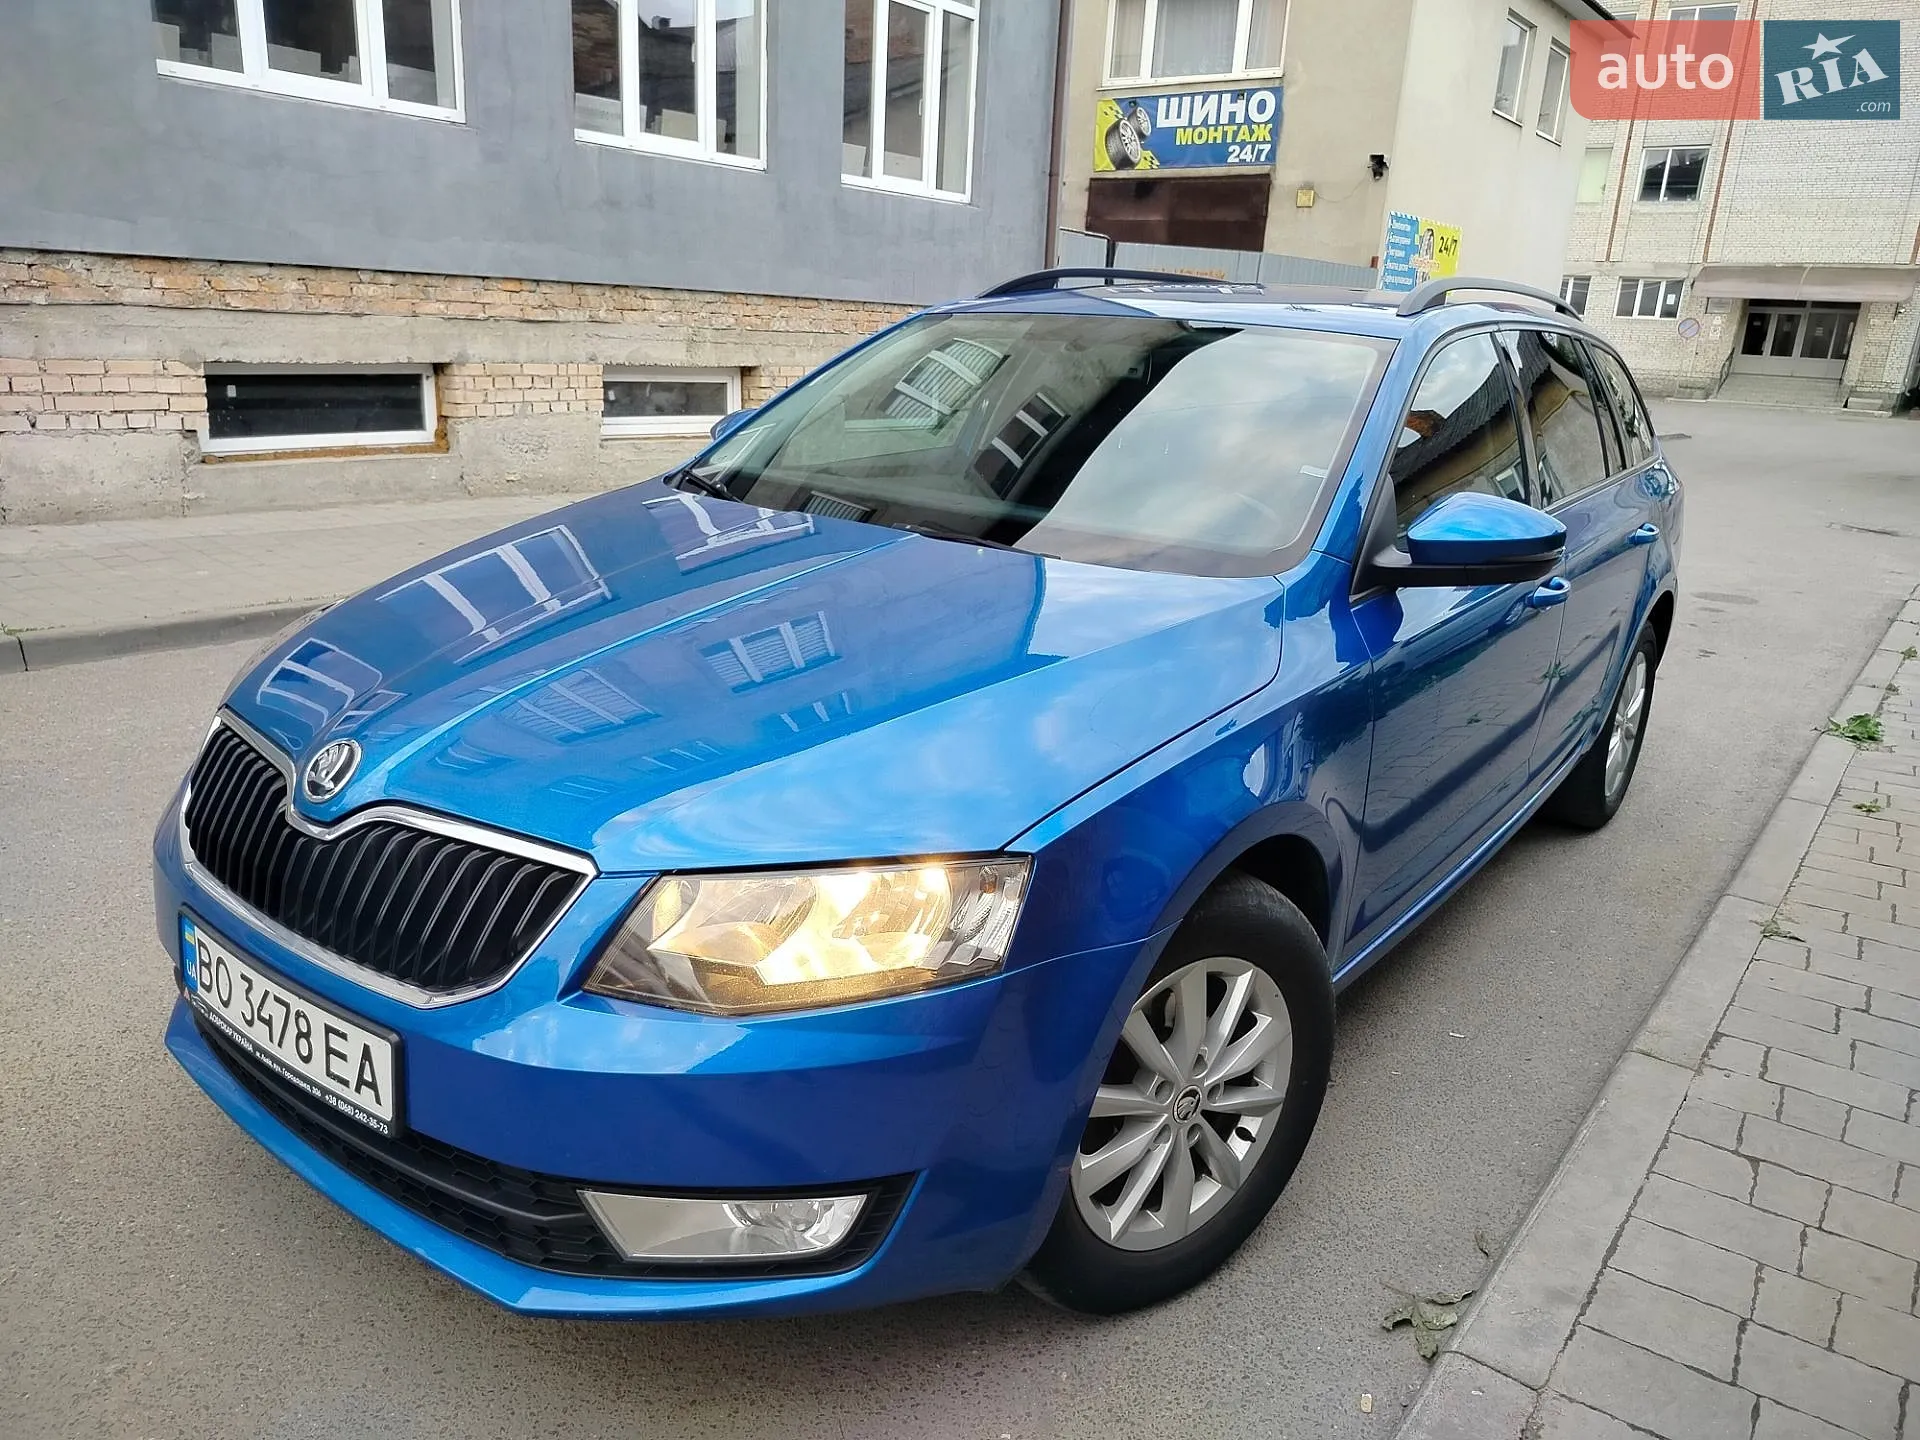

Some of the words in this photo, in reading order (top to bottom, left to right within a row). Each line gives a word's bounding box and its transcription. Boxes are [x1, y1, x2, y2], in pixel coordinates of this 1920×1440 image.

[1156, 90, 1276, 128] ШИНО
[1175, 123, 1273, 145] МОНТАЖ
[1227, 144, 1271, 163] 24/7
[1438, 235, 1458, 257] 24/7
[186, 958, 197, 981] UA
[240, 971, 313, 1065] 3478
